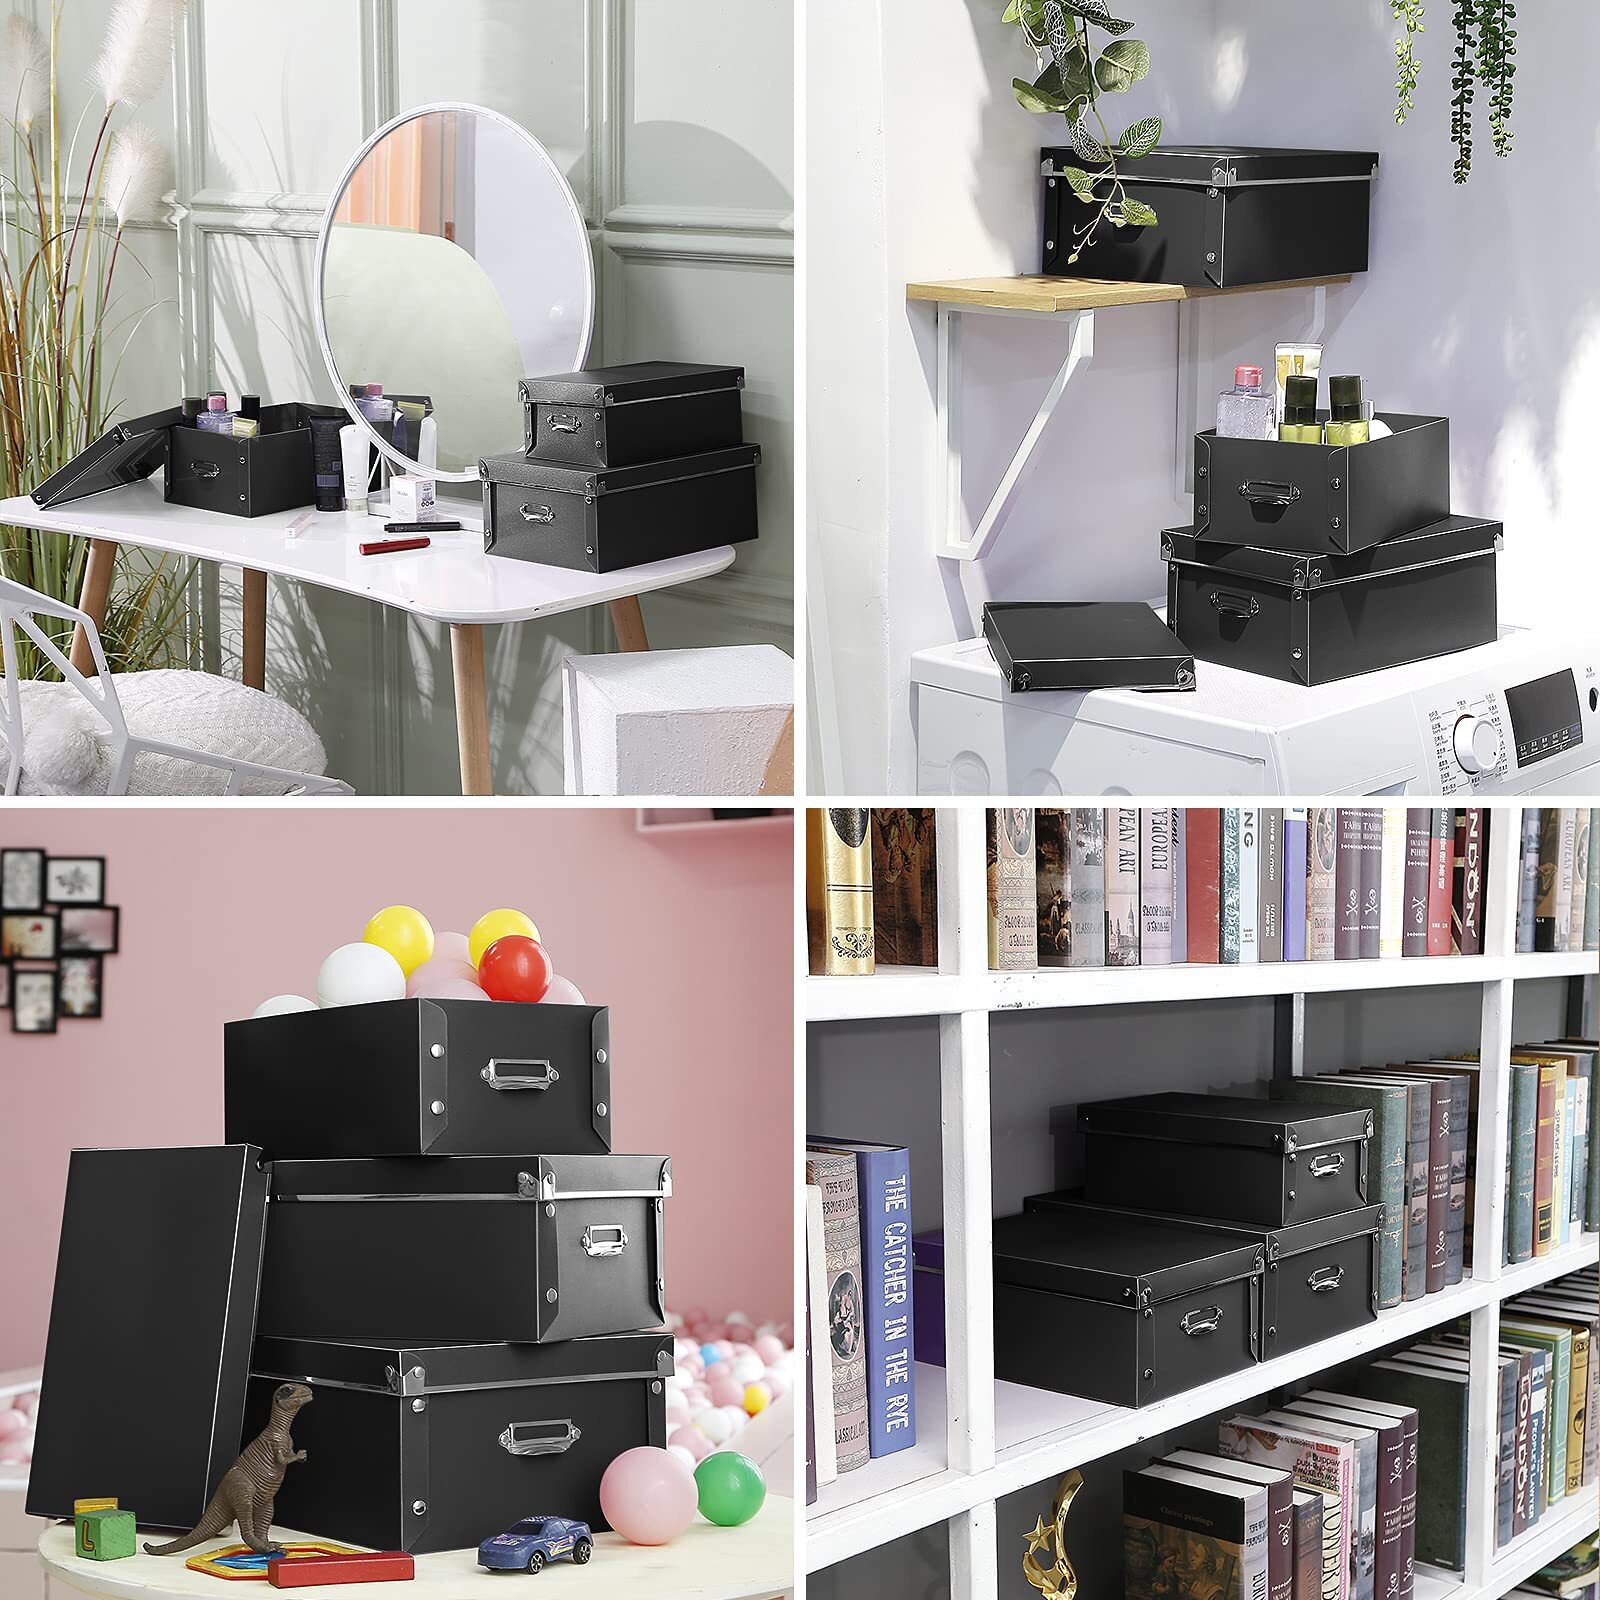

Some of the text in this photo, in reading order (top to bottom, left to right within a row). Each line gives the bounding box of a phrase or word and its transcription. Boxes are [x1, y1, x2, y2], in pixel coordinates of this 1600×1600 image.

[1151, 808, 1168, 870] EUROPEA
[1244, 812, 1253, 848] NG
[1119, 848, 1136, 875] ART
[1269, 844, 1275, 855] TO
[883, 1174, 910, 1435] THE CATCHER IN THE RYE
[835, 1425, 858, 1444] LASSICAL
[1528, 1418, 1539, 1520] PEOPLE'S LAWYER
[82, 1520, 95, 1552] L
